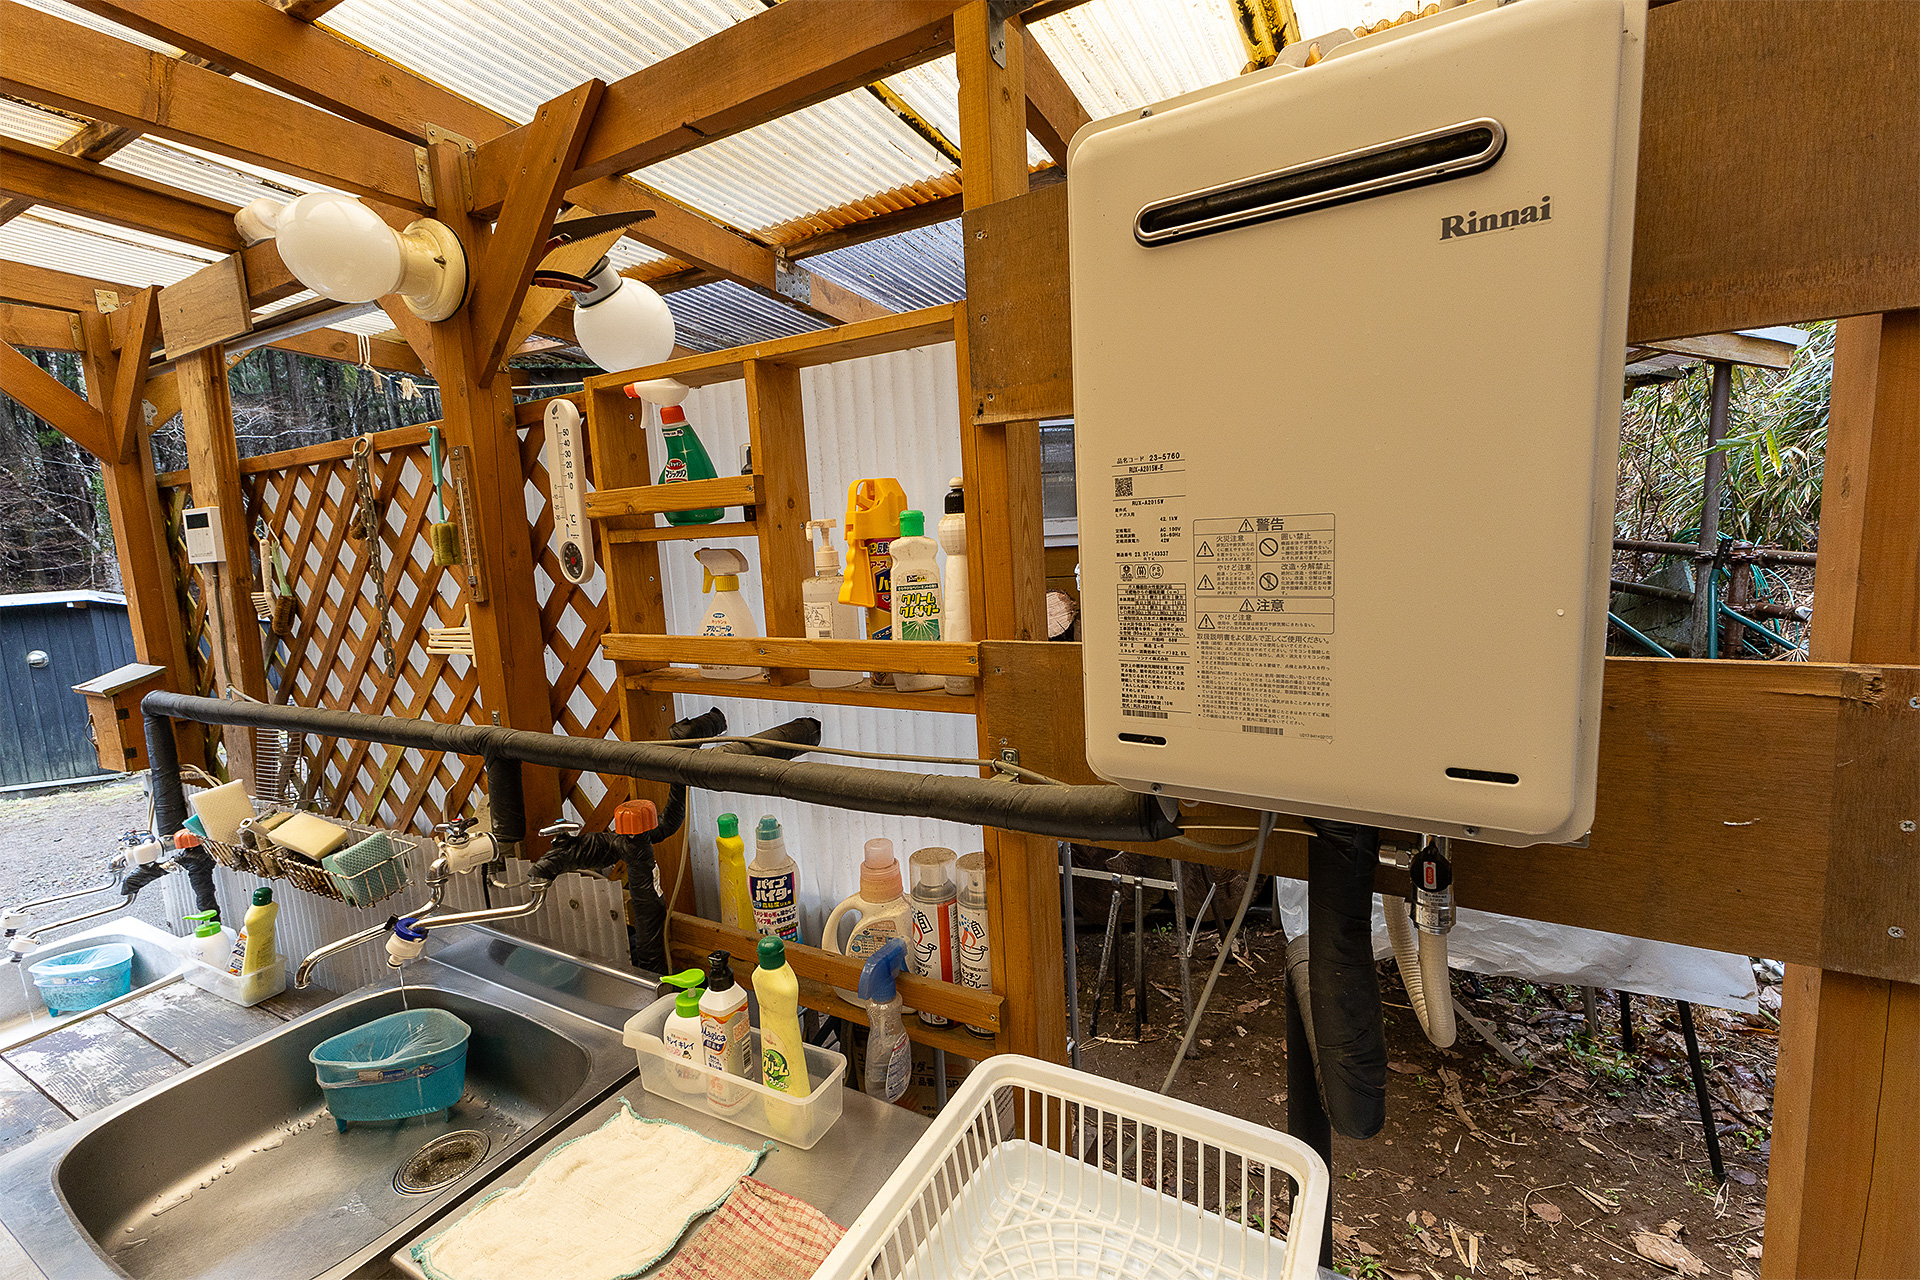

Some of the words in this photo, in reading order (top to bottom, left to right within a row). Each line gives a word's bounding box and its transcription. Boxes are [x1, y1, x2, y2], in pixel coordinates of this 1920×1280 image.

[1440, 196, 1551, 240] Rinnai
[1116, 456, 1144, 464] 品名コード
[1149, 452, 1180, 461] 23-5760
[1128, 464, 1164, 473] RUX-A2015W-E
[1256, 517, 1284, 531] 警告
[870, 560, 887, 569] アース
[879, 576, 891, 591] ハ
[901, 592, 936, 605] クリーム
[899, 604, 940, 618] クレンザー
[1257, 599, 1284, 612] 注意
[756, 876, 787, 889] パイプ
[756, 887, 791, 902] ハイター
[701, 1026, 726, 1042] Magica
